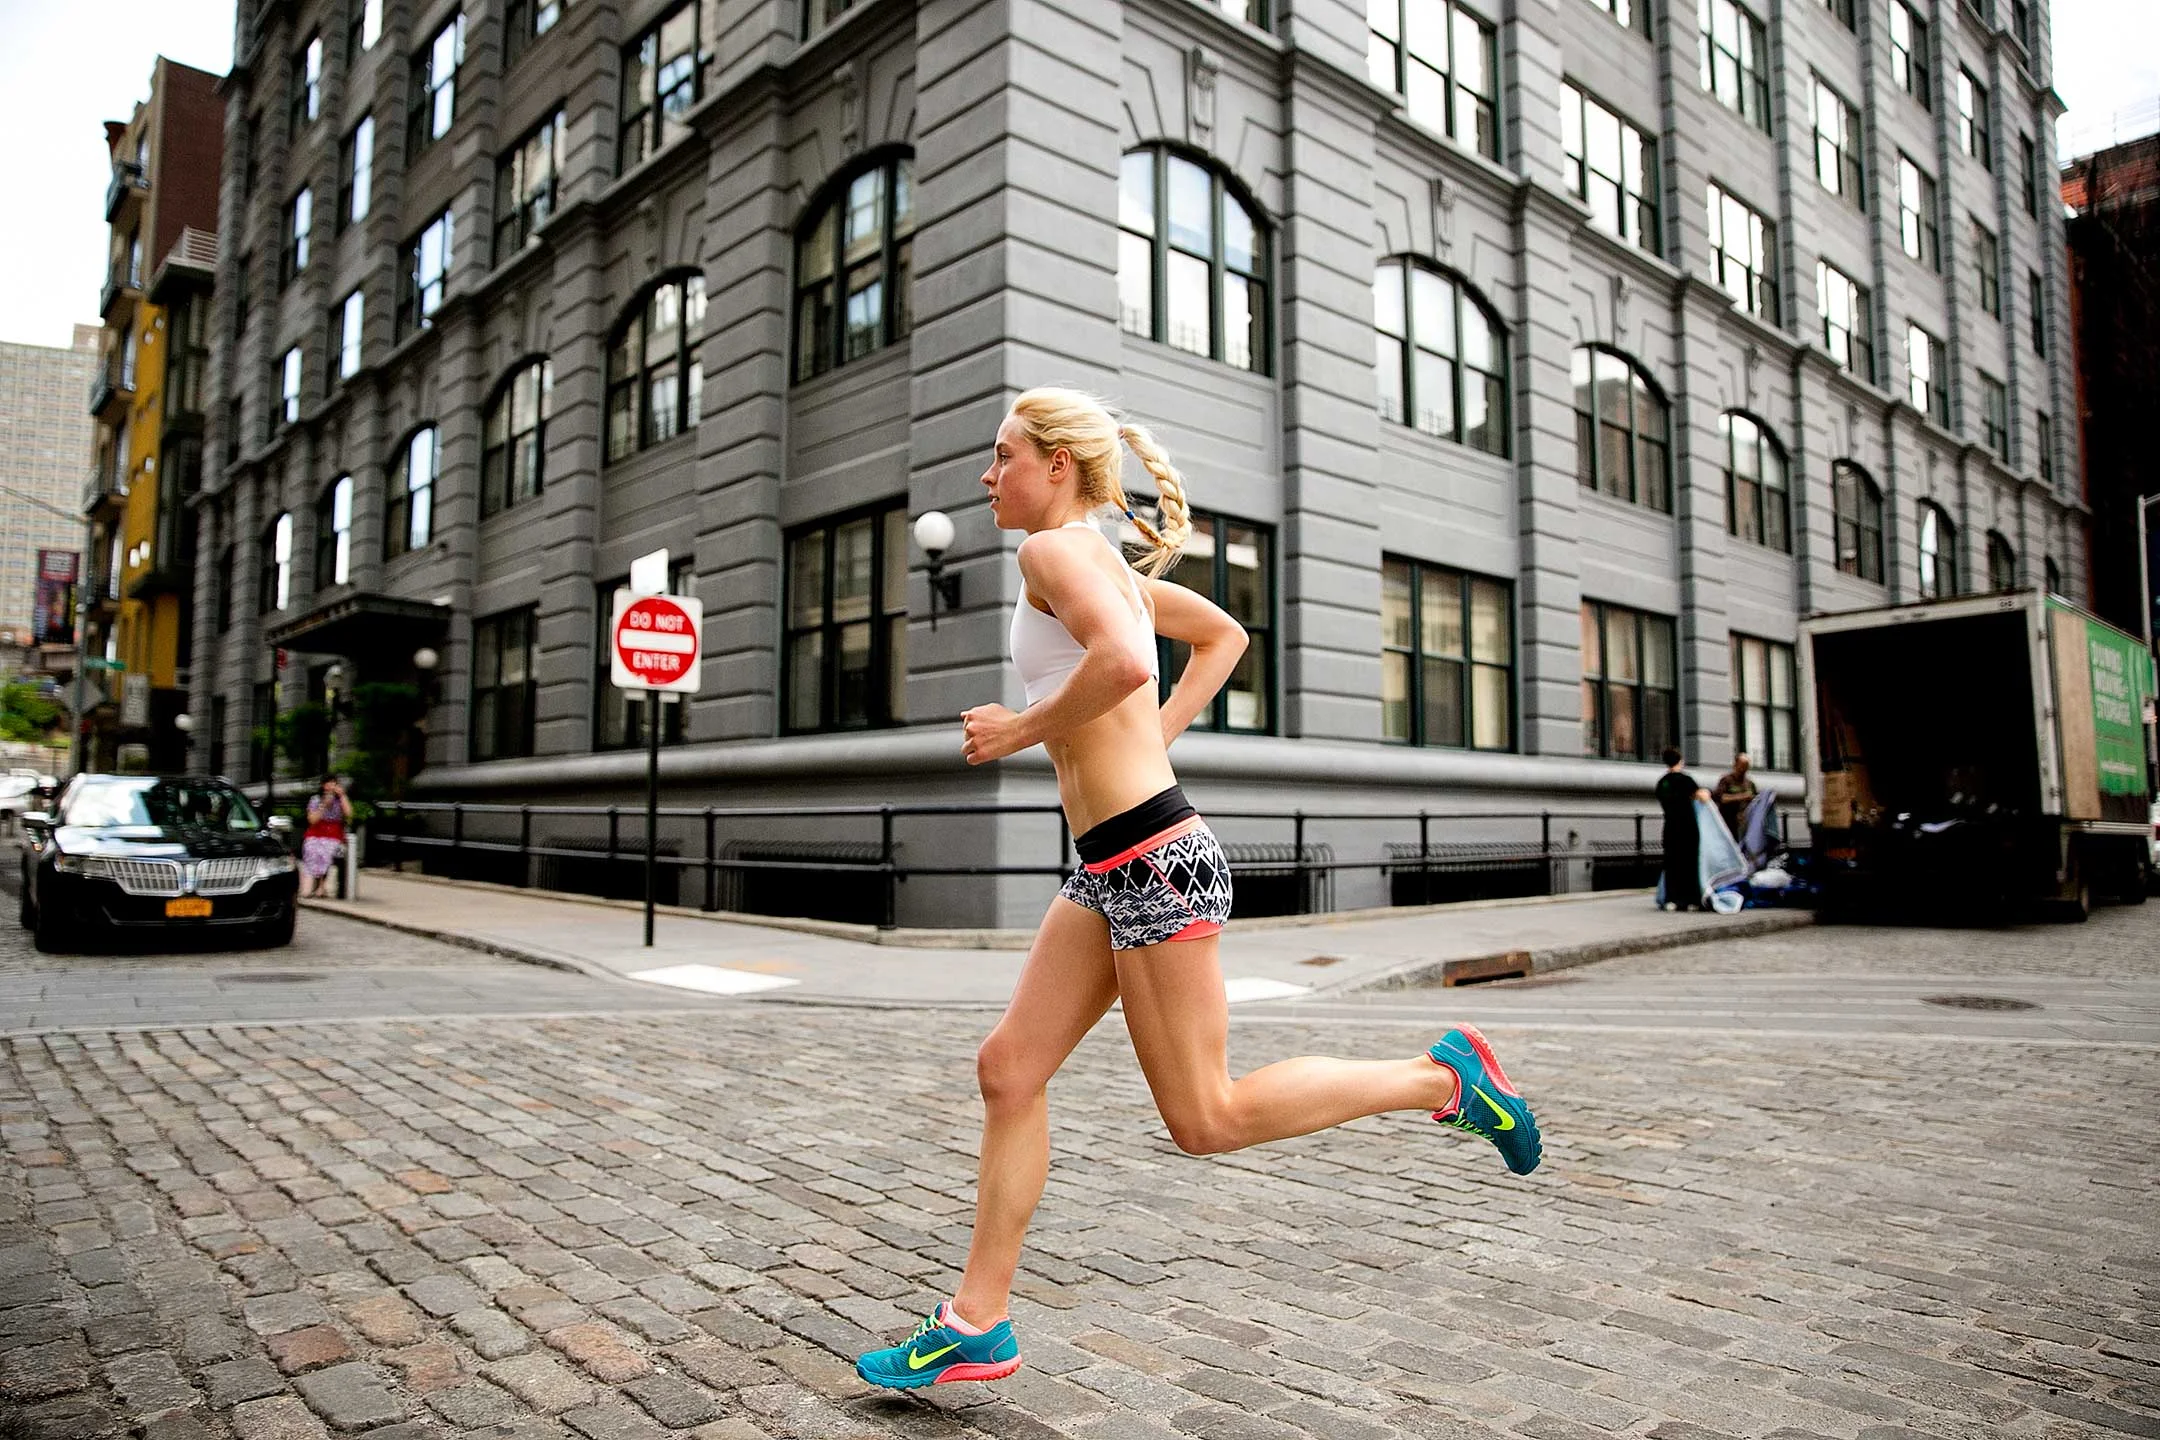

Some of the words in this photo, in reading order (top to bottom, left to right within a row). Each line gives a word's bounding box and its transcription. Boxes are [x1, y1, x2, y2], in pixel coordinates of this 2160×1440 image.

[629, 610, 652, 629] DO
[655, 613, 685, 632] NOT
[632, 651, 680, 672] ENTER
